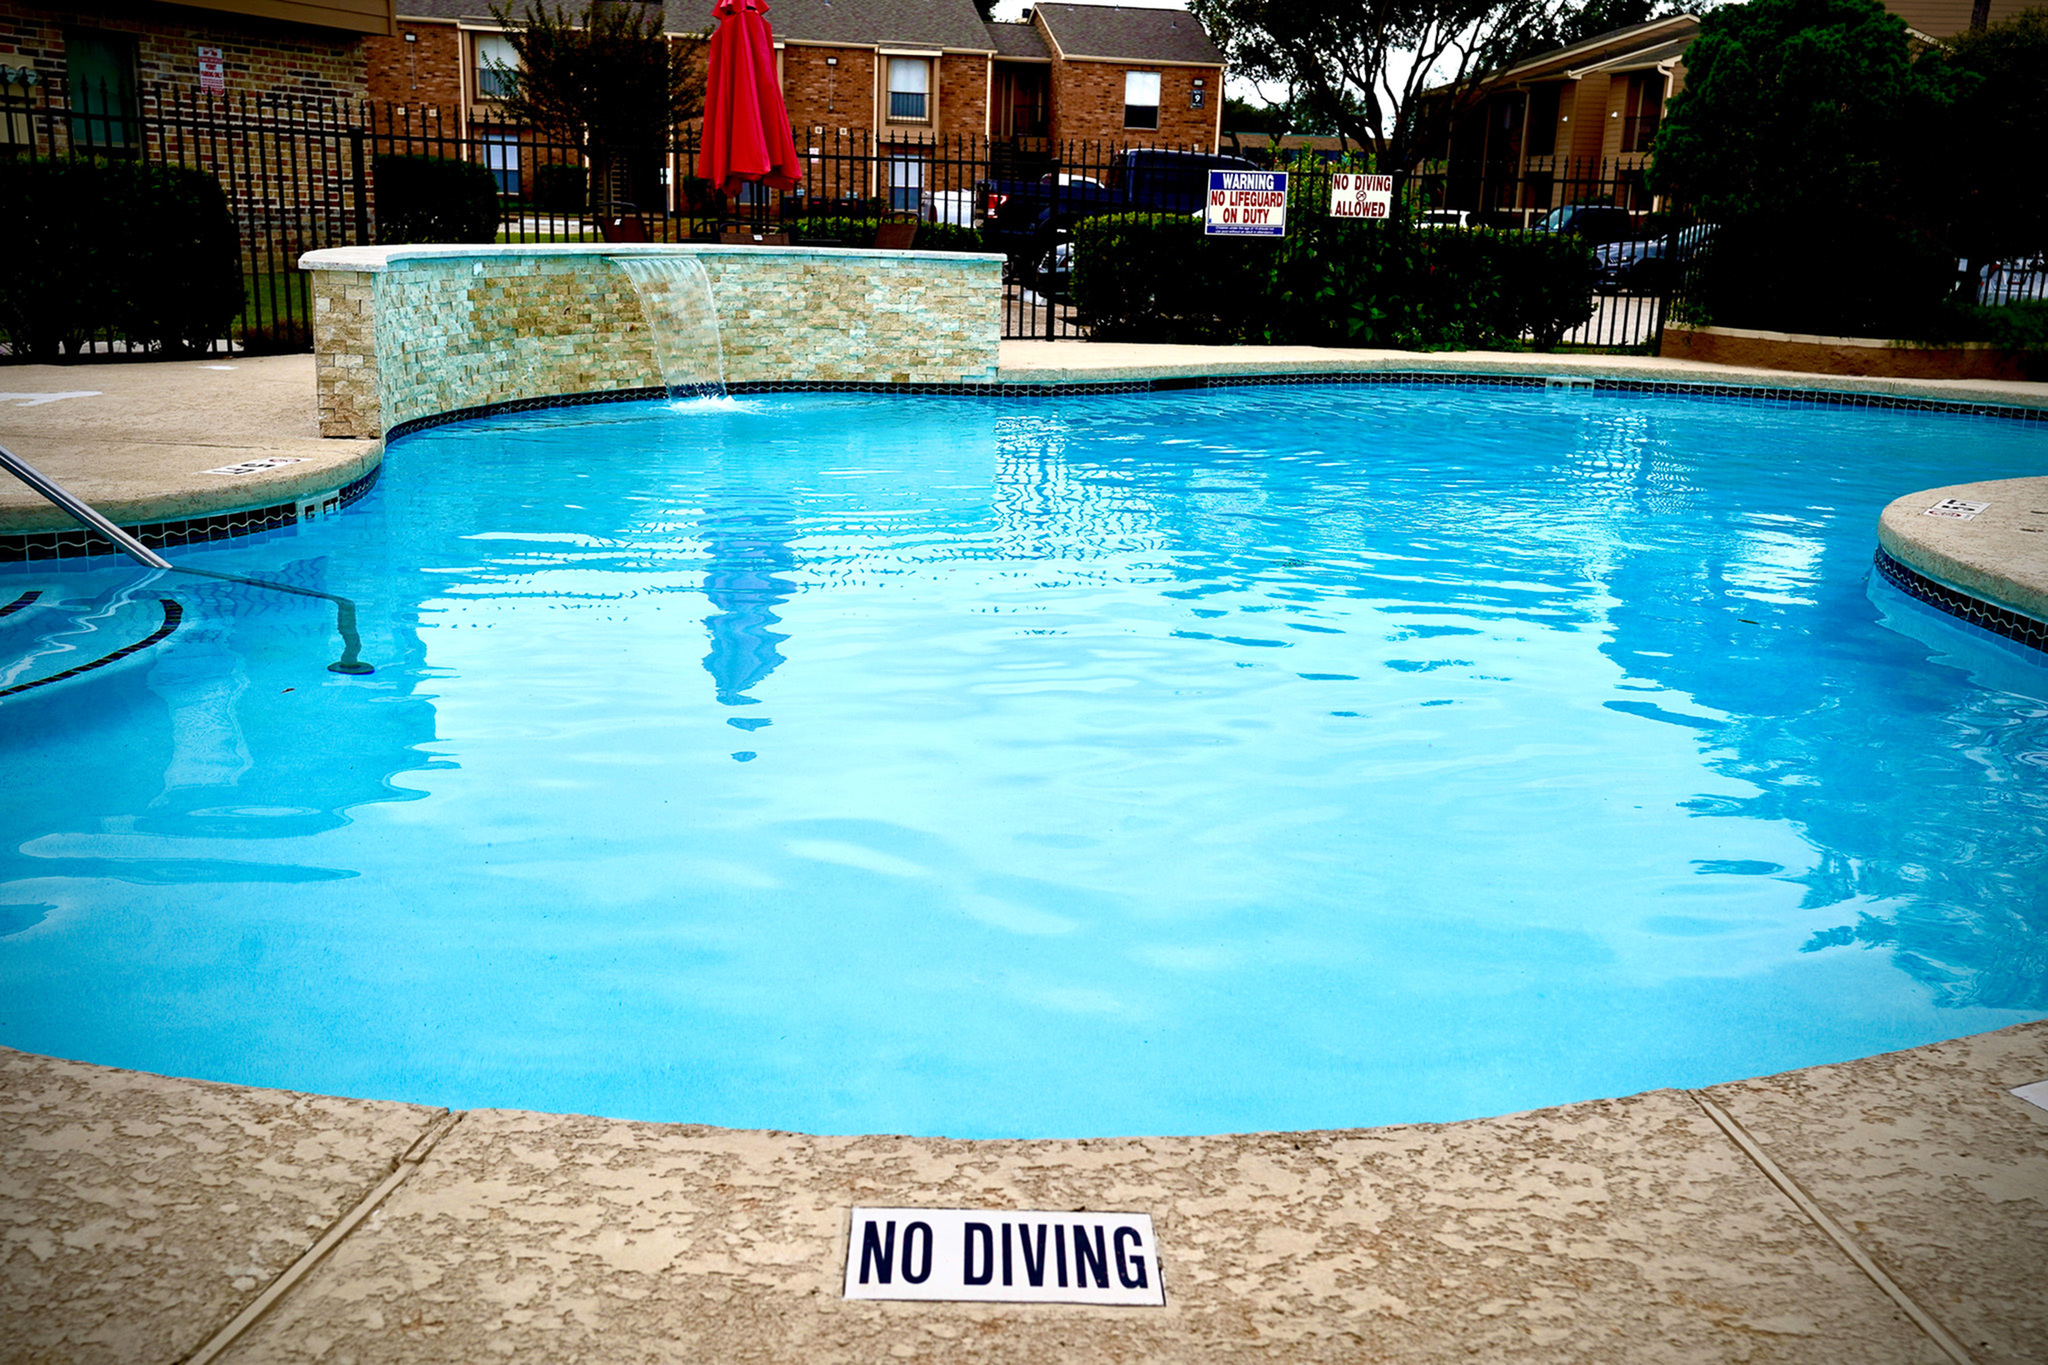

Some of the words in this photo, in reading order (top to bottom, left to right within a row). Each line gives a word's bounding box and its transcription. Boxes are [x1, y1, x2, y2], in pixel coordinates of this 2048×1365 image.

[1223, 173, 1274, 190] WARNING
[1334, 175, 1349, 190] NO
[1354, 175, 1391, 191] DIVING
[1210, 191, 1225, 206] NO
[1229, 191, 1284, 207] LIFEGUARD
[1223, 207, 1238, 223] ON
[1242, 208, 1270, 224] DUTY
[1335, 201, 1386, 217] ALLOWED
[859, 1220, 934, 1284] NO
[963, 1221, 1149, 1289] DIVING
